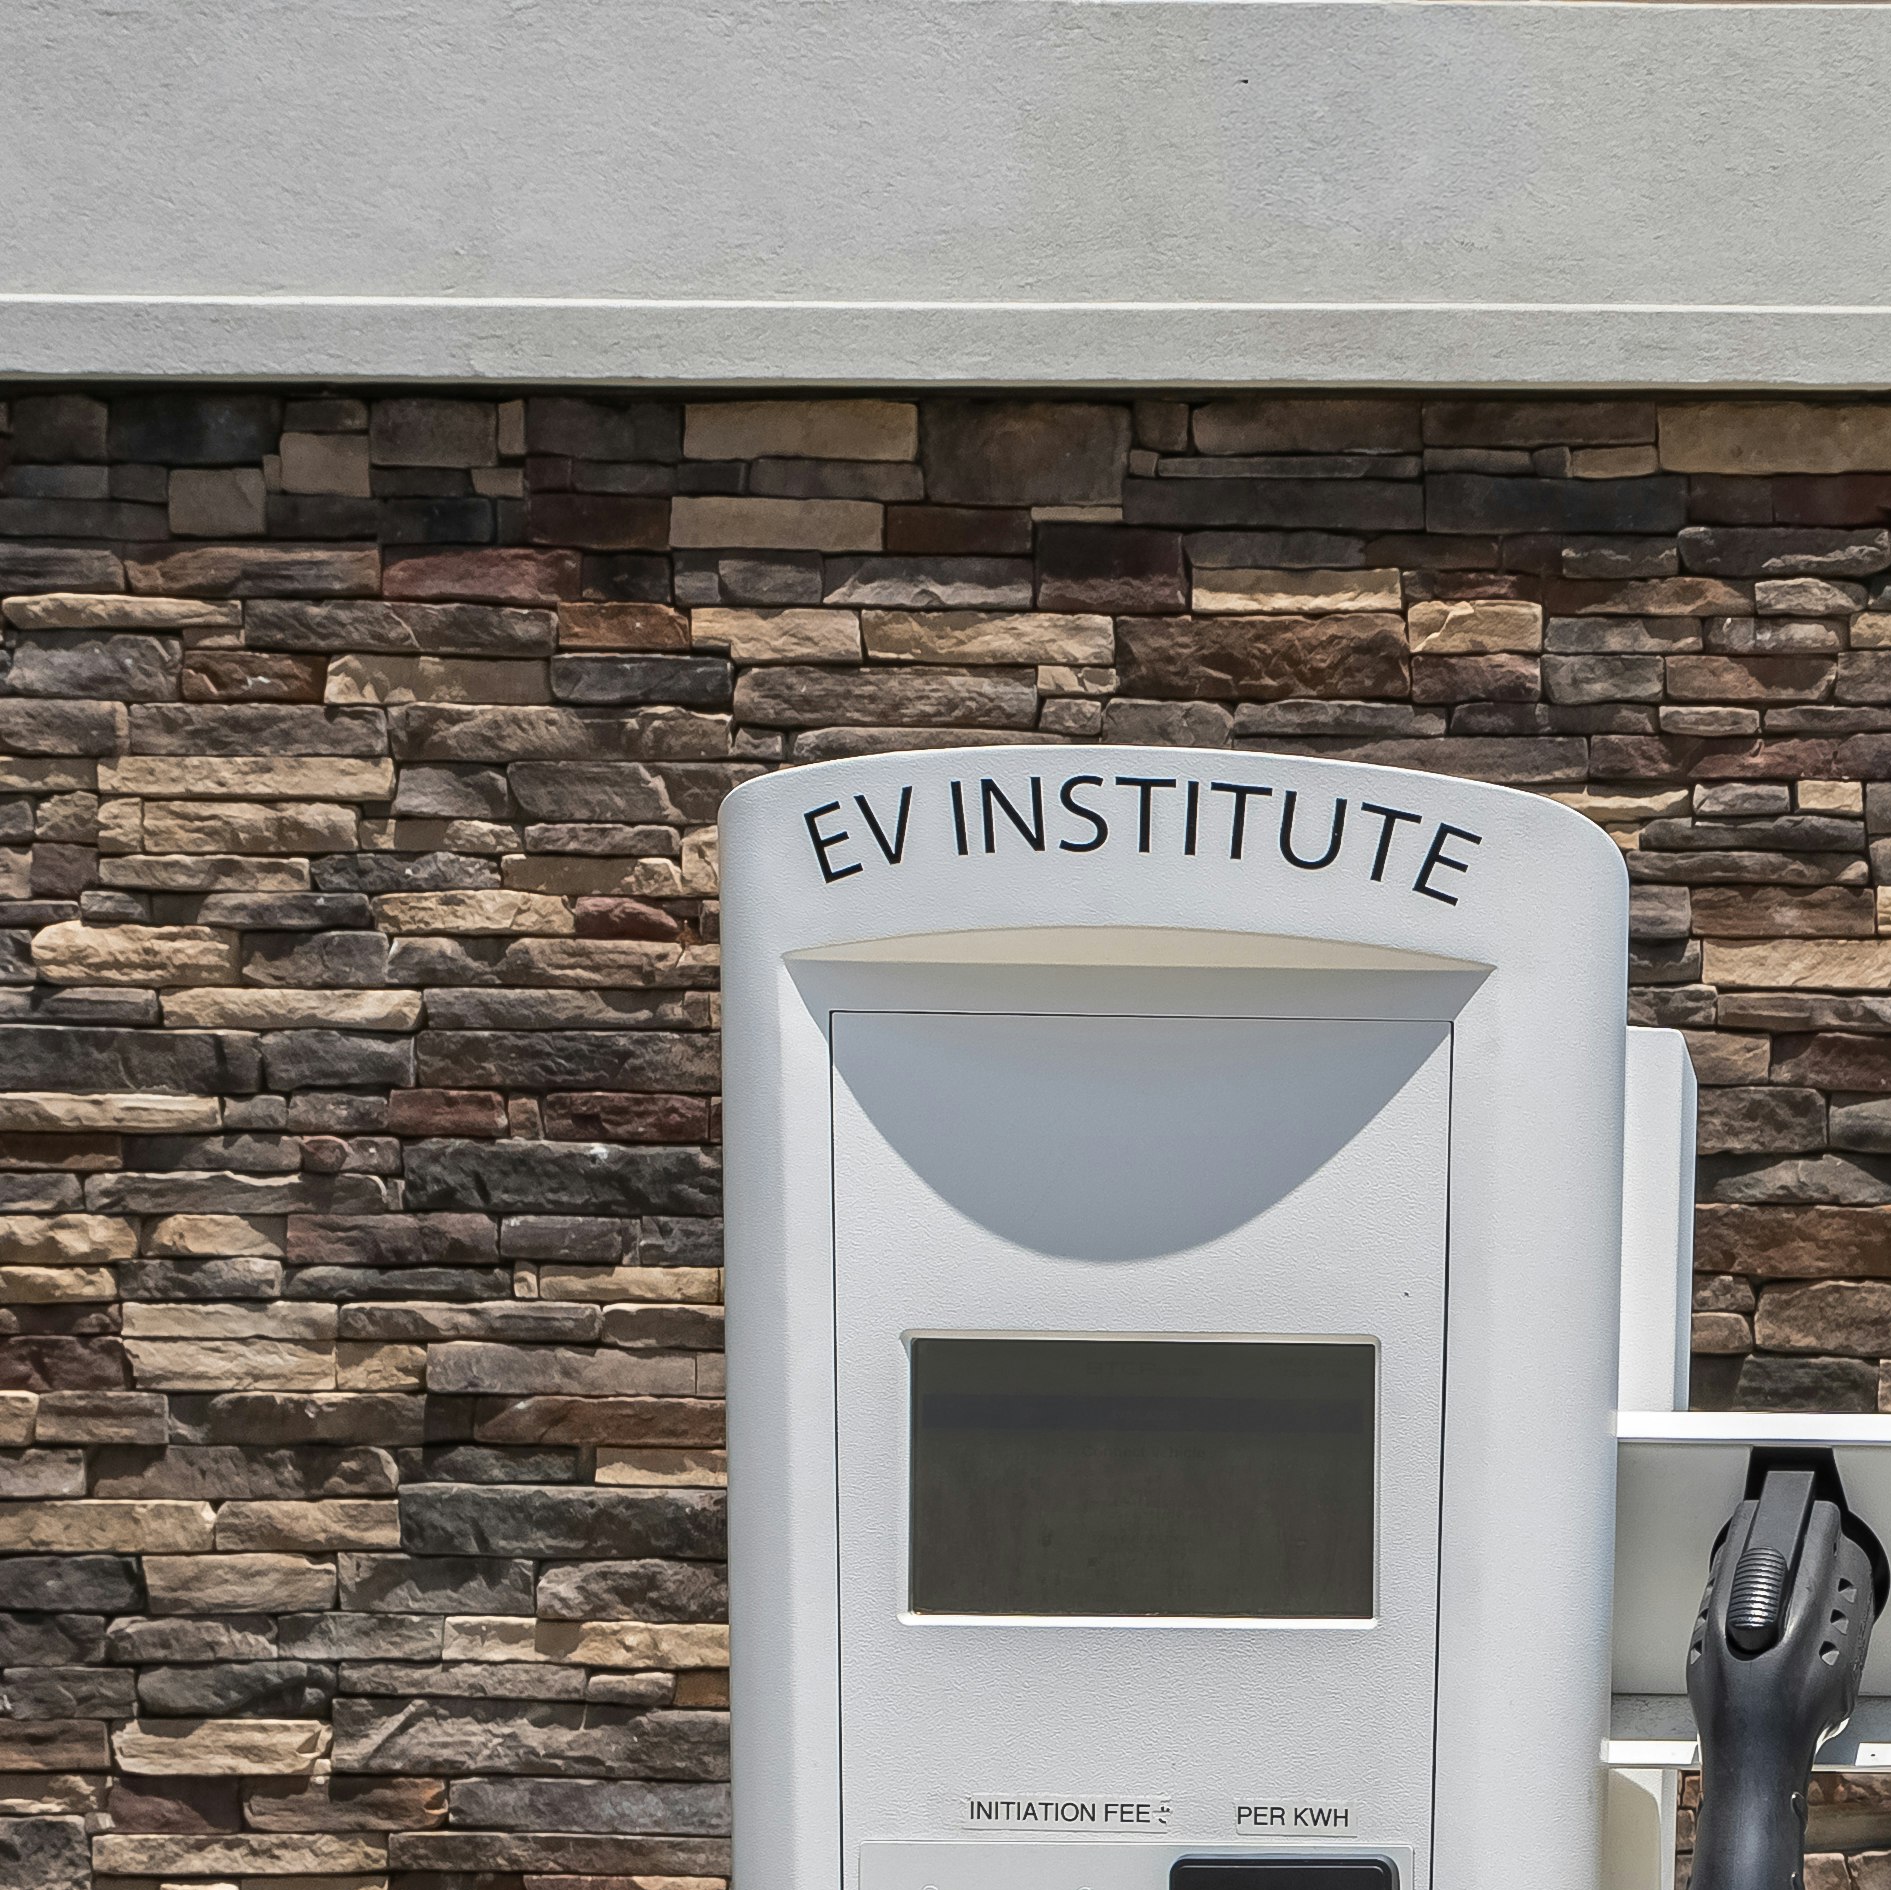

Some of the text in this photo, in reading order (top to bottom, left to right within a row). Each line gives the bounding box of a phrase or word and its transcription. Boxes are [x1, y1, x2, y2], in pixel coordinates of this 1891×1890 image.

[804, 775, 1483, 906] EV INSTITUTE
[970, 1800, 1096, 1822] INITIATION
[1104, 1803, 1151, 1823] FEE
[1237, 1806, 1286, 1826] PER
[1294, 1807, 1349, 1828] KWH
